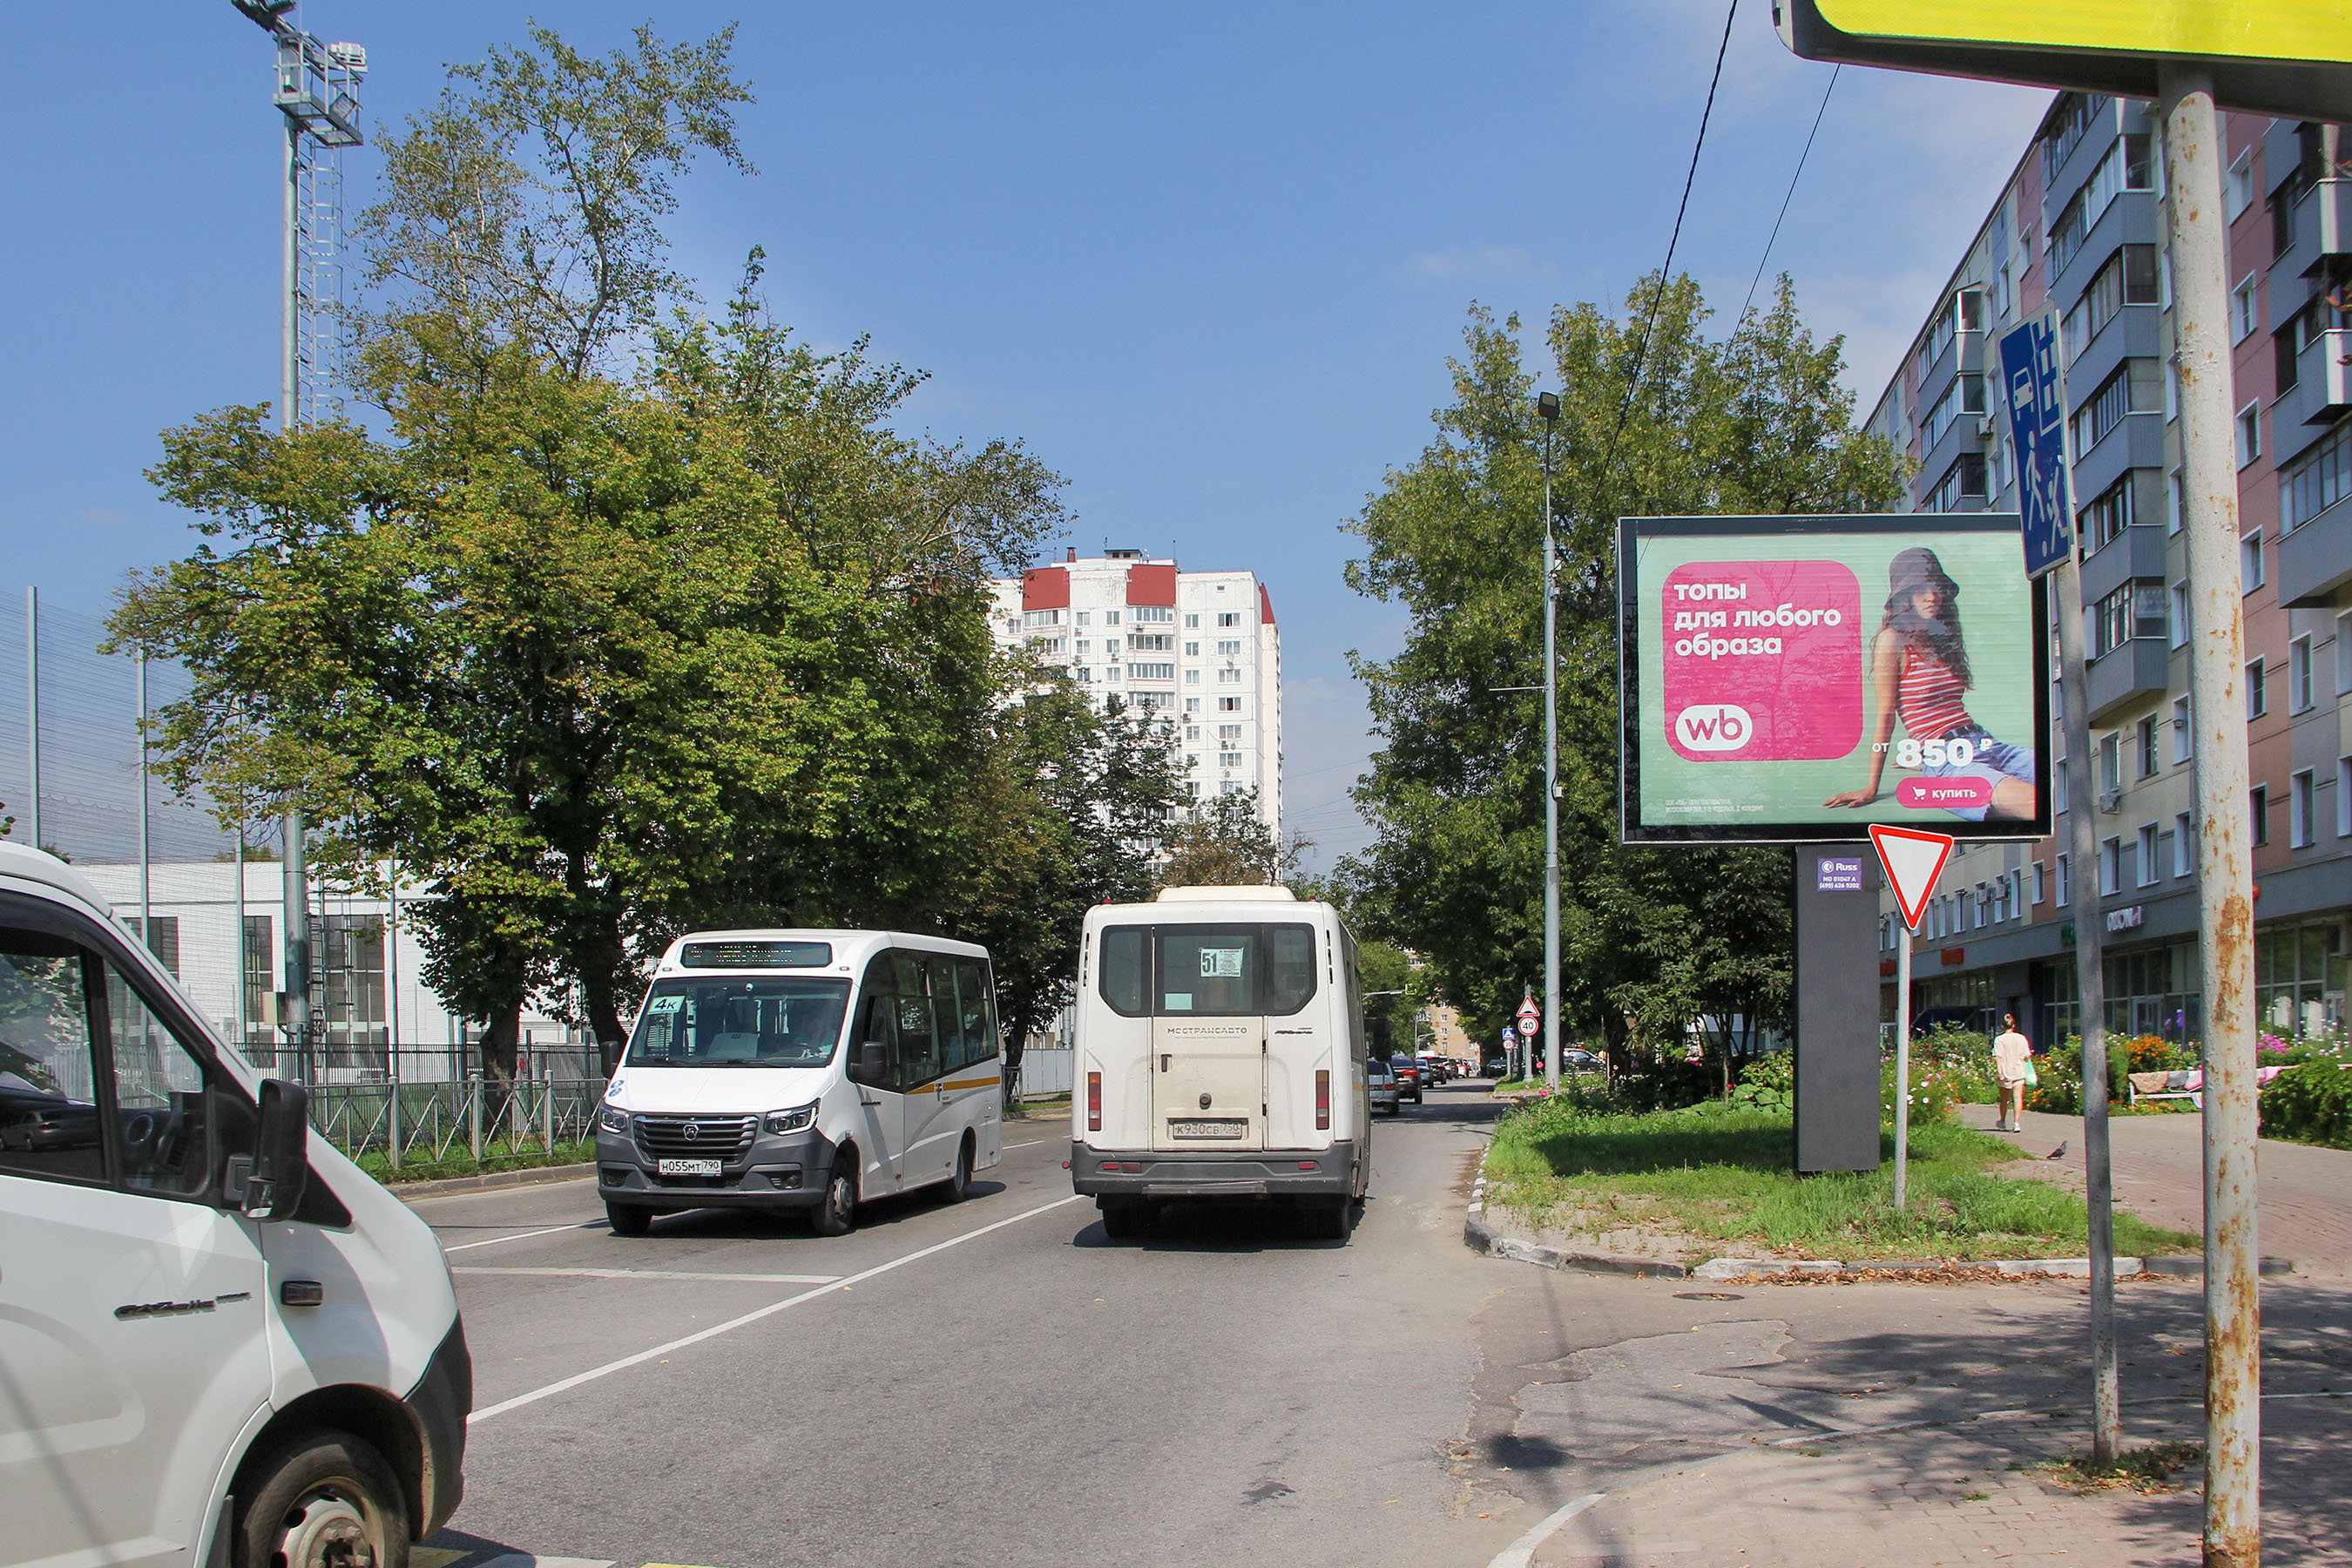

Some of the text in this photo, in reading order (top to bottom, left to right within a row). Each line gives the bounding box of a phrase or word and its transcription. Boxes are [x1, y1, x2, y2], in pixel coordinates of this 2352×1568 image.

[1673, 583, 1747, 601] топы
[1673, 603, 1842, 632] для любого
[1674, 632, 1782, 661] образа
[1684, 708, 1743, 741] wb
[1872, 742, 1889, 753] от
[1896, 738, 1974, 767] 850
[1931, 788, 1977, 801] купить
[1835, 862, 1858, 871] Russ
[1202, 952, 1217, 973] 51
